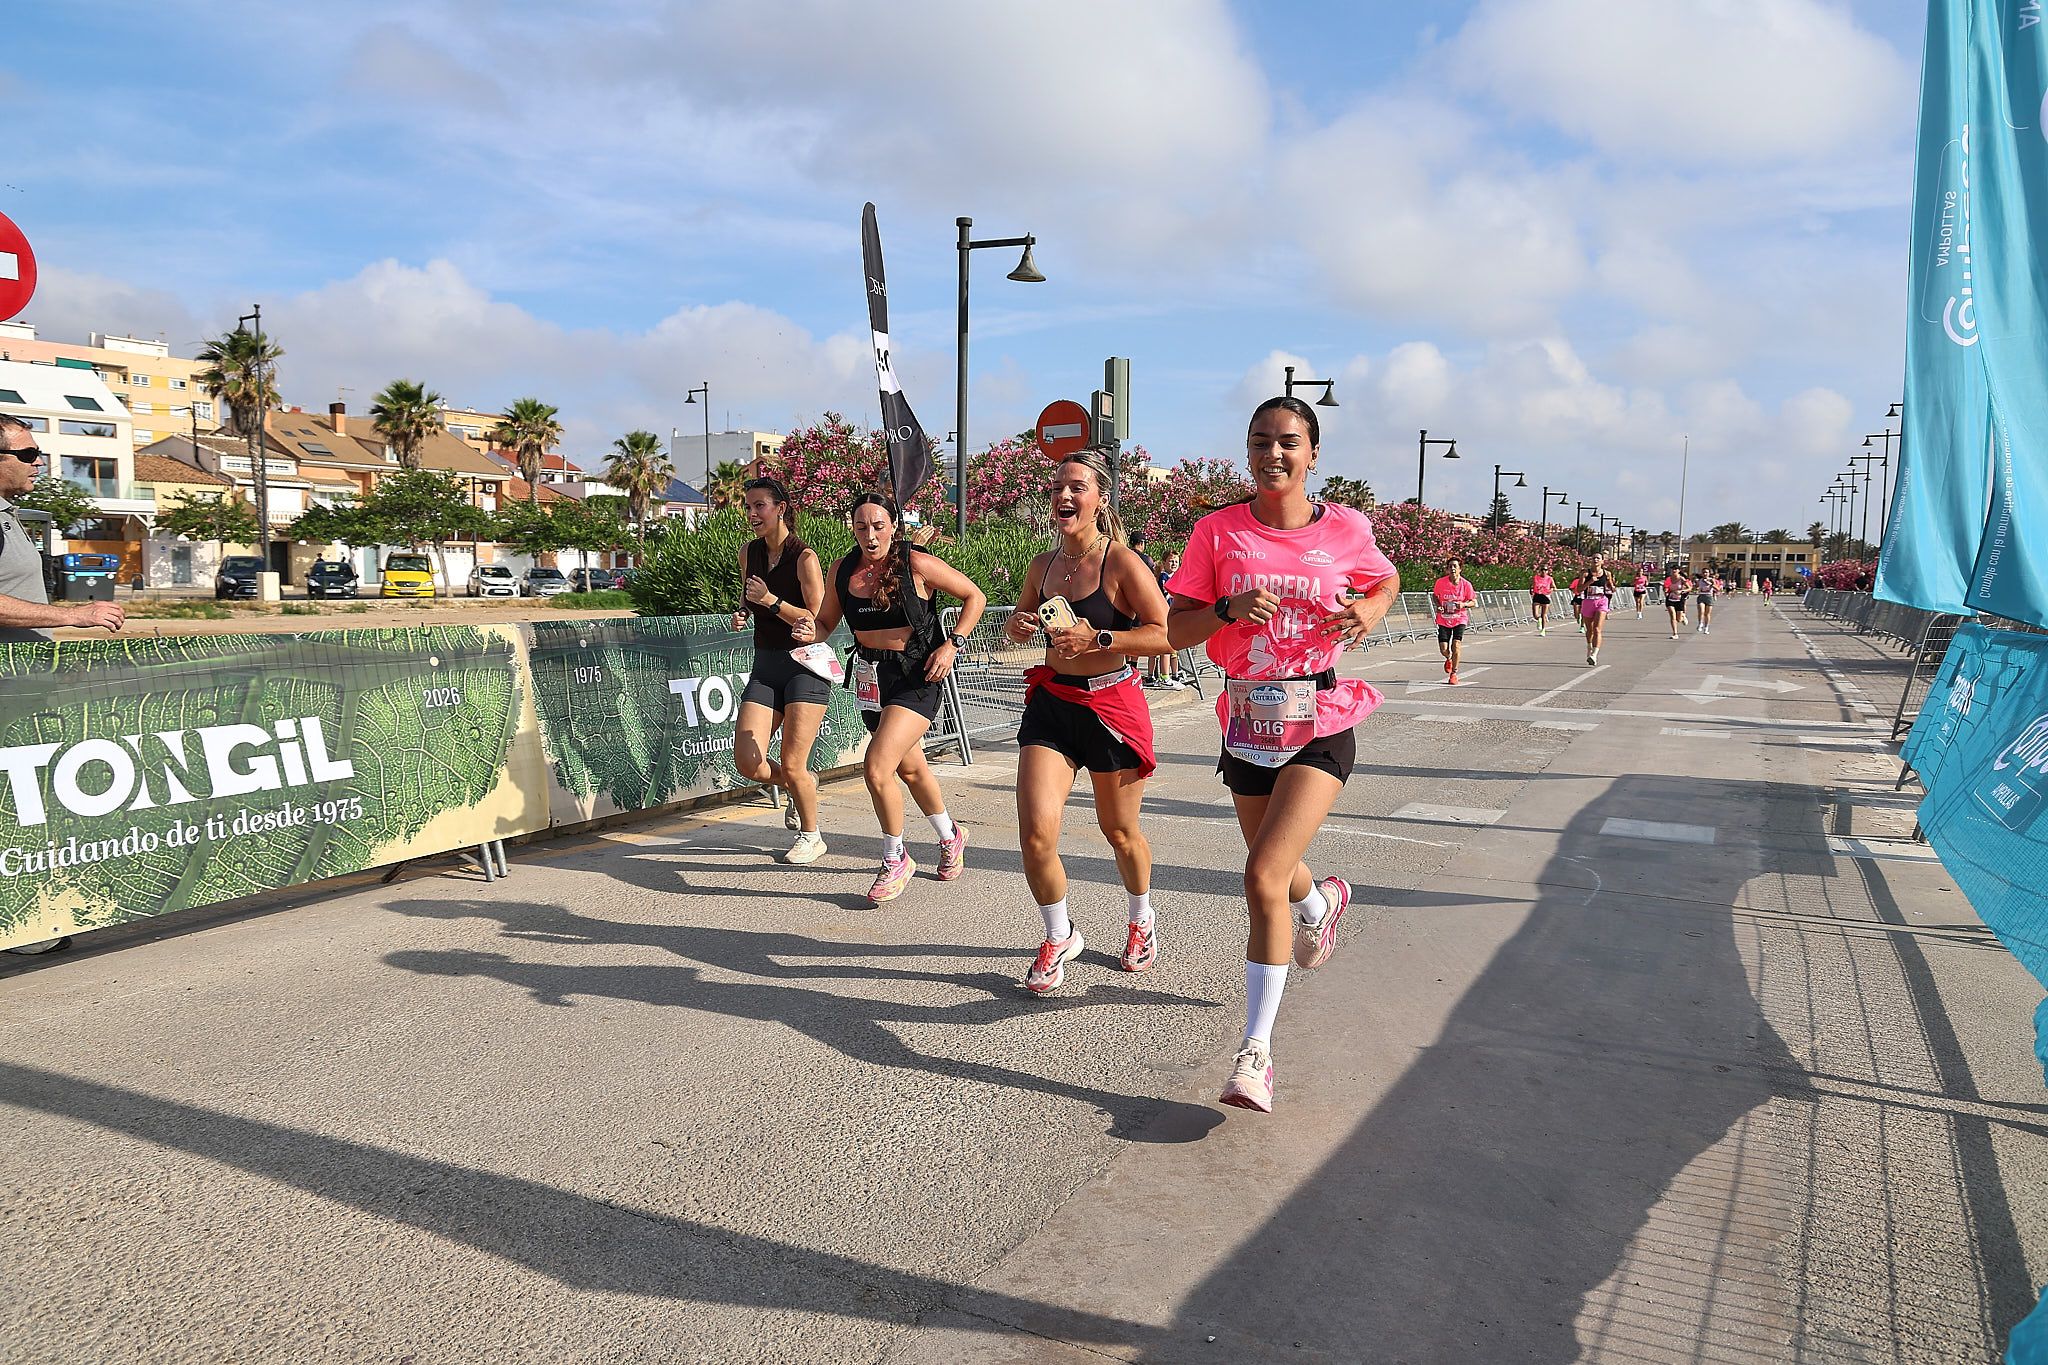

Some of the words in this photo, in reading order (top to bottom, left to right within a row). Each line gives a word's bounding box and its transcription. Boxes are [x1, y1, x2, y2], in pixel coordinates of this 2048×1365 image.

[1227, 550, 1266, 559] OYSHO
[1231, 574, 1321, 601] CARRERA
[573, 665, 602, 684] 1975
[423, 686, 461, 709] 2026
[1253, 720, 1284, 736] 016
[682, 731, 736, 757] Cuidand
[1, 827, 159, 877] Cuidando
[166, 819, 200, 844] de
[207, 813, 225, 841] ti
[232, 801, 306, 836] desde
[312, 796, 363, 825] 1975
